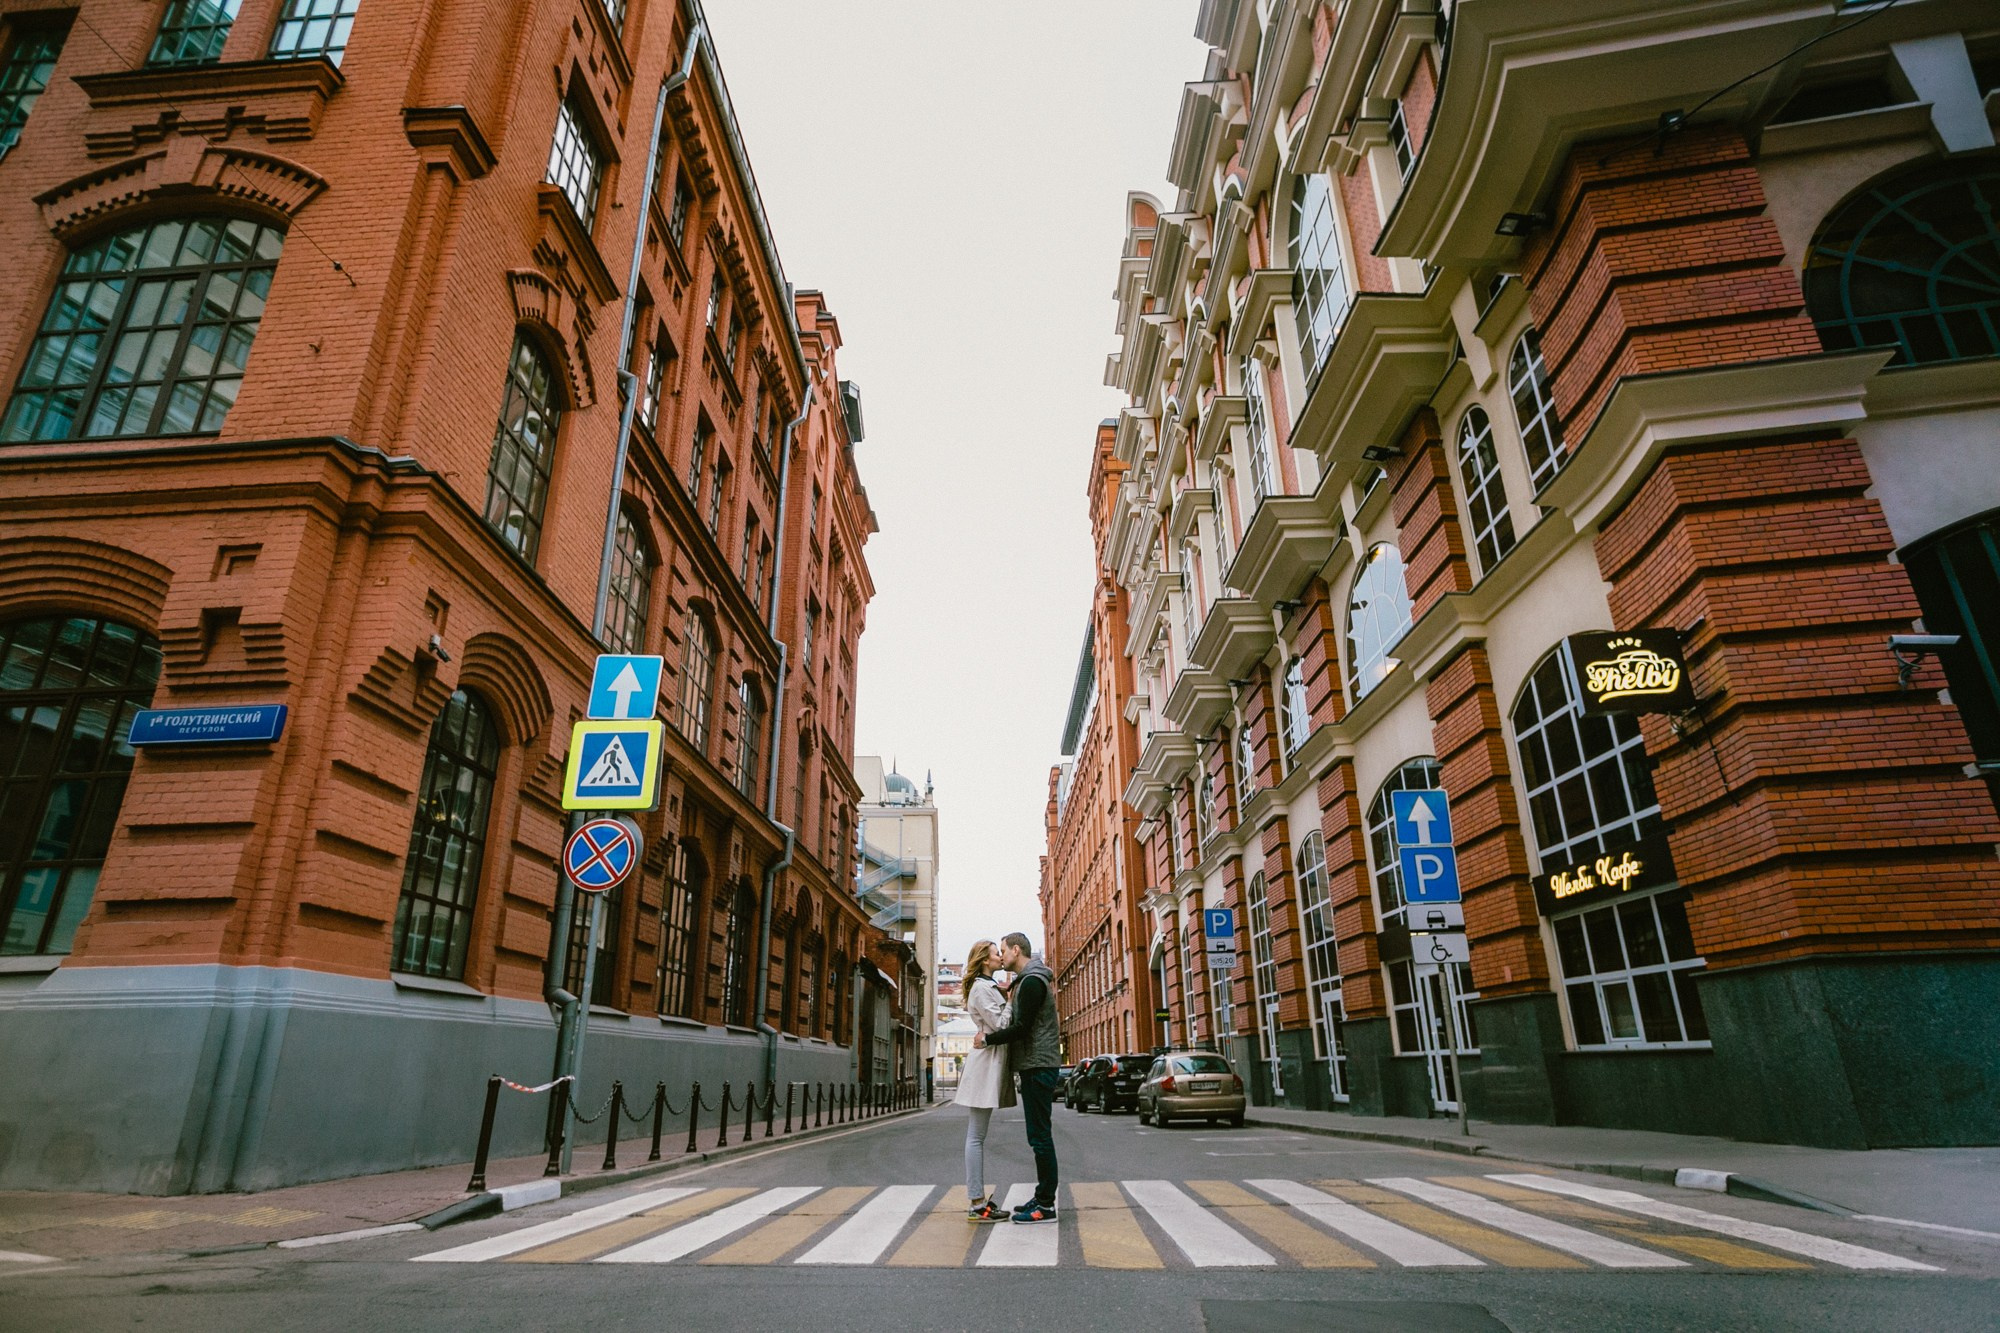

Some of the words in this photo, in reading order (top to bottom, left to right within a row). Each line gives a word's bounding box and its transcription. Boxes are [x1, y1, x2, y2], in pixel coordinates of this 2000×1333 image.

[1607, 637, 1641, 649] КАФЕ
[1586, 664, 1680, 700] Shelby
[164, 711, 261, 726] ГОЛУТВИНСКИЙ
[1414, 854, 1443, 894] P
[1550, 865, 1594, 899] Шелби
[1595, 852, 1640, 891] Кафе
[1212, 913, 1227, 934] P
